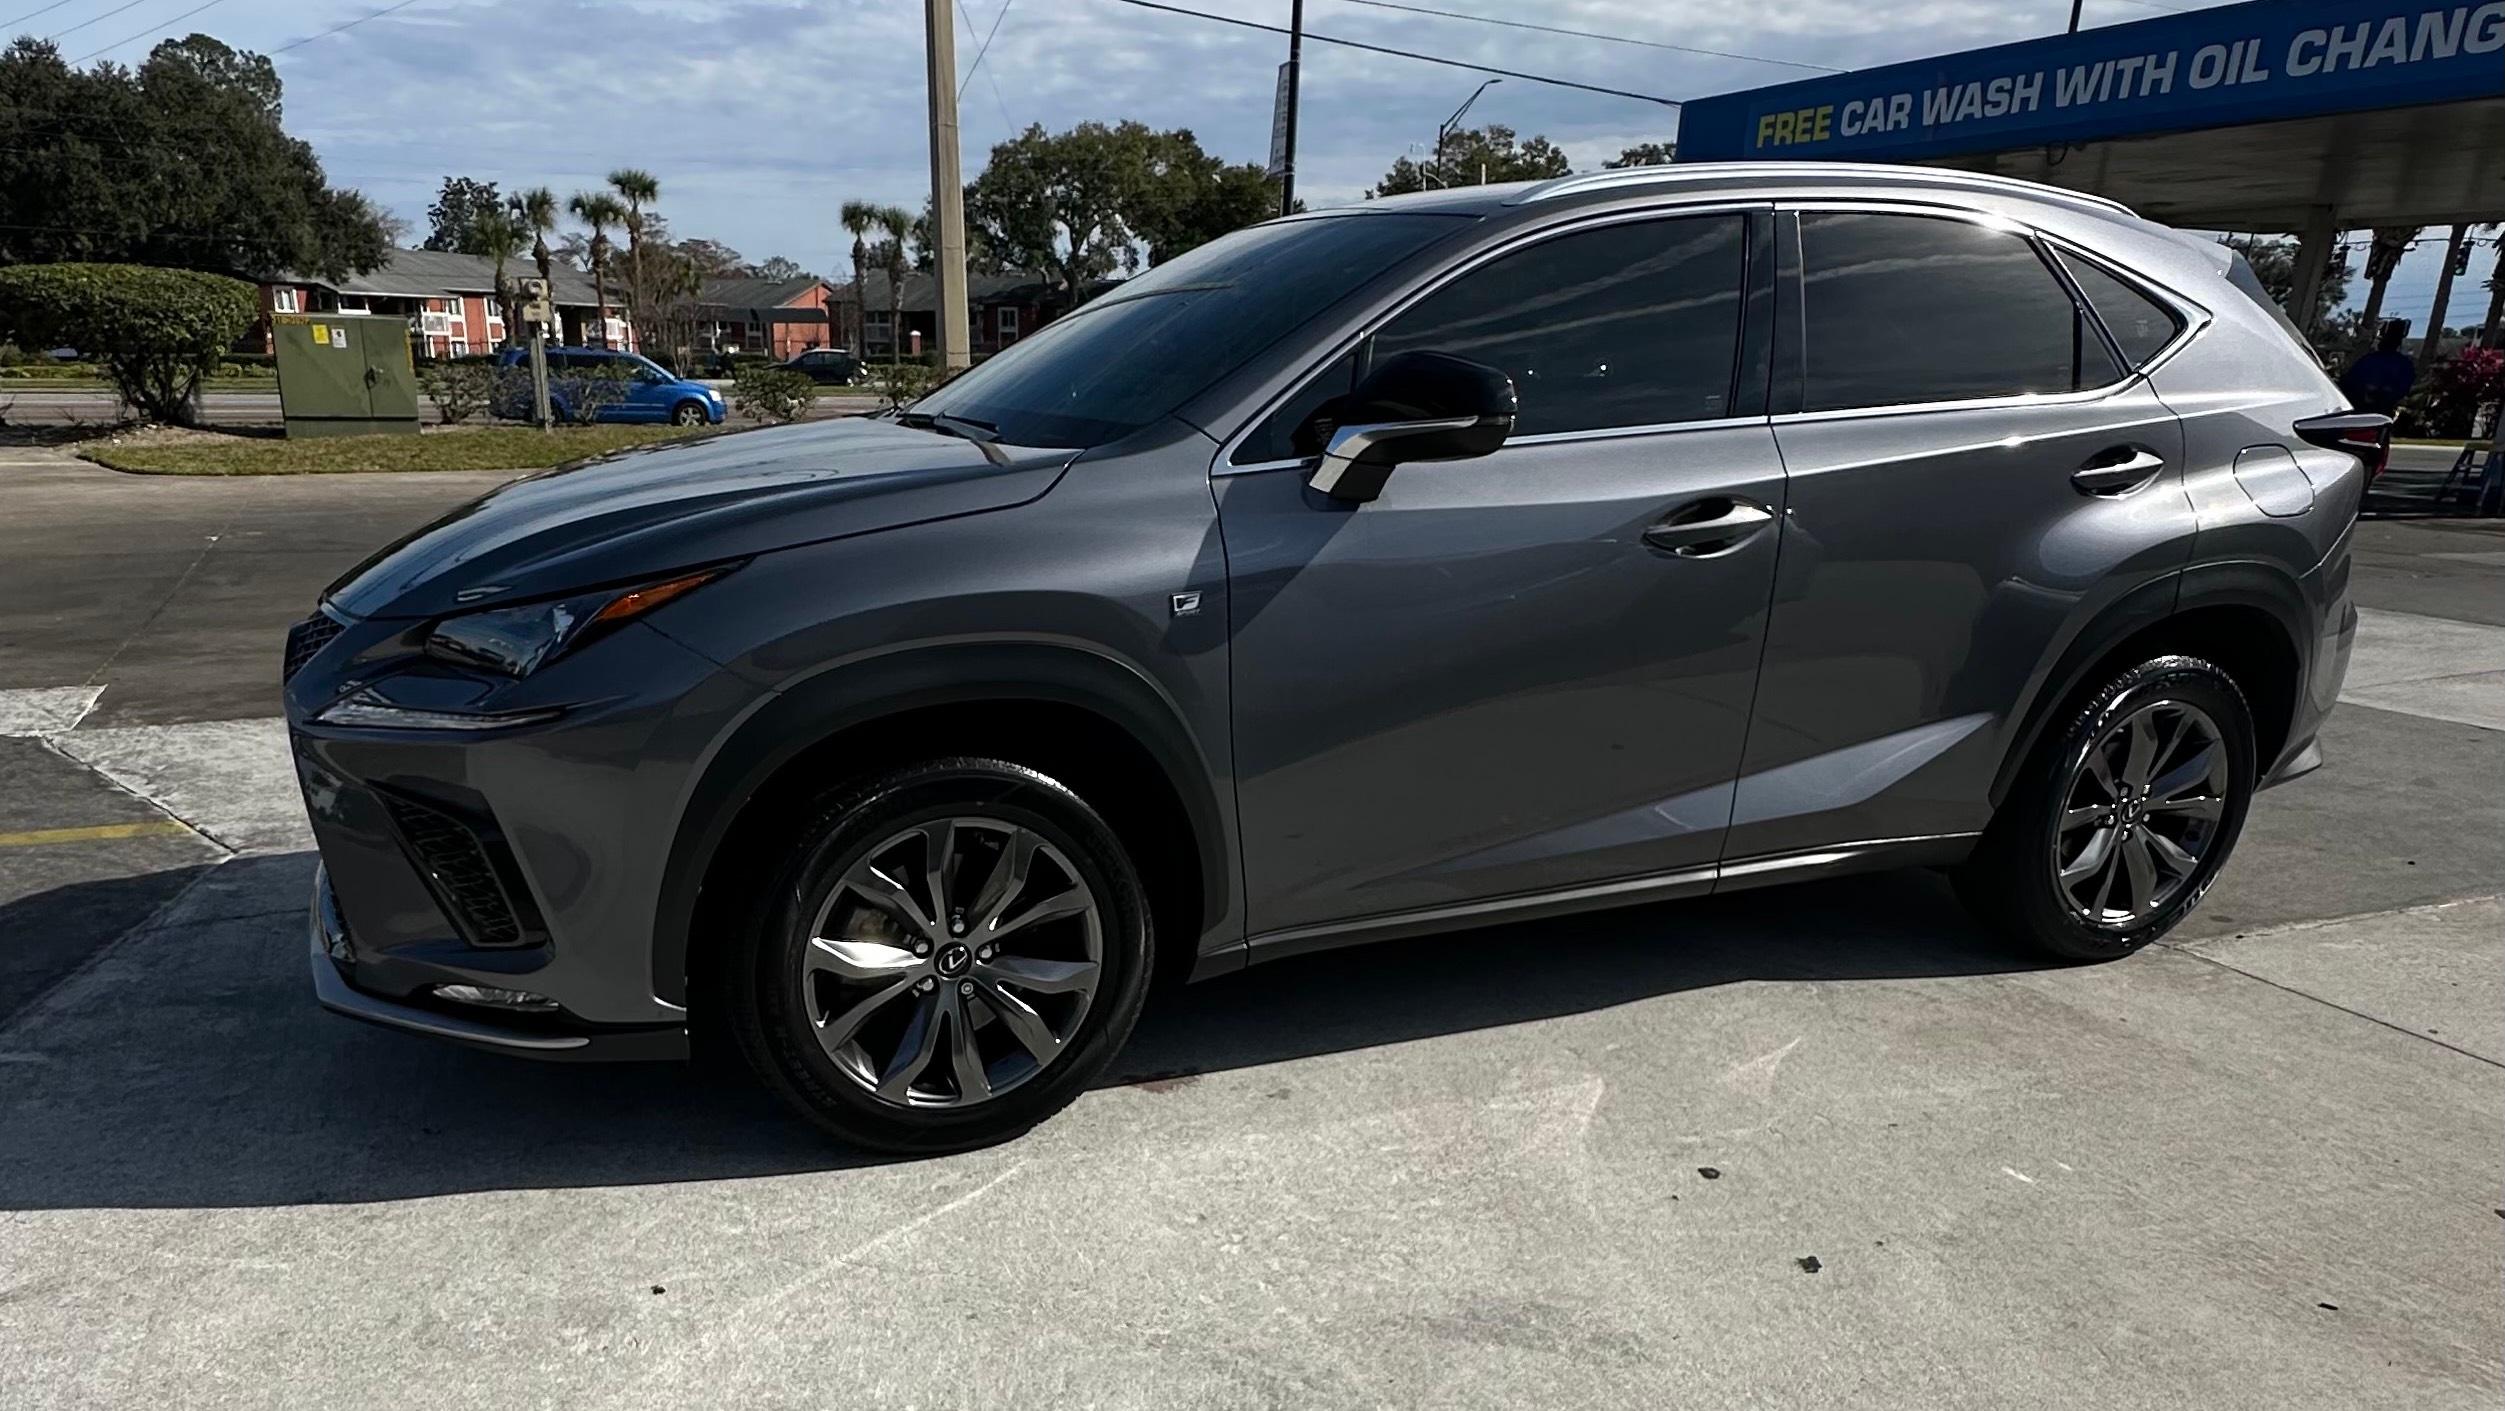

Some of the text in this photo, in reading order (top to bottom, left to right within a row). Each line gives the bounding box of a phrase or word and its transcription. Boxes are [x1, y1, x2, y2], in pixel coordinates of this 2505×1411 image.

[1757, 106, 1833, 148] FREE
[1841, 94, 1912, 137] CAR
[1923, 72, 2043, 125] WASH
[2056, 52, 2177, 107] WITH
[2189, 39, 2268, 88] OIL
